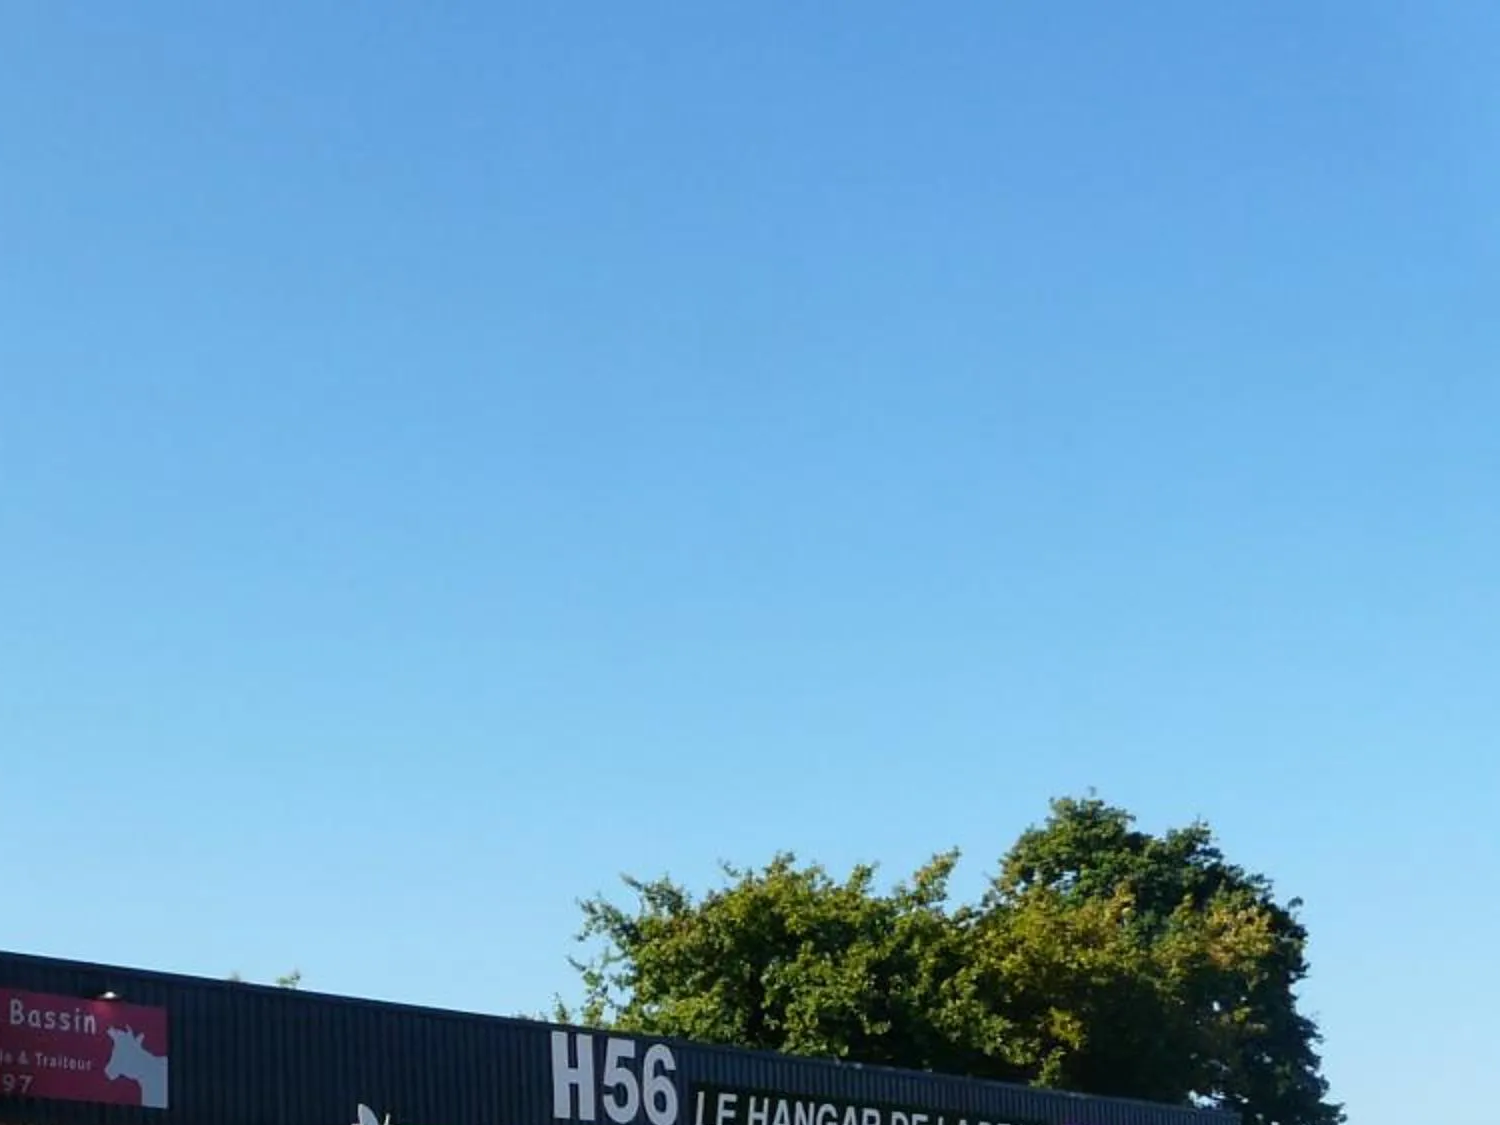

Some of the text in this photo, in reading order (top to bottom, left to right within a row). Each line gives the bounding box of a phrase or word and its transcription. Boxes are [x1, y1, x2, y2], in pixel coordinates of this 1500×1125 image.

[9, 999, 97, 1035] Bassin
[34, 1052, 93, 1071] Traiteur
[2, 1073, 35, 1095] 97
